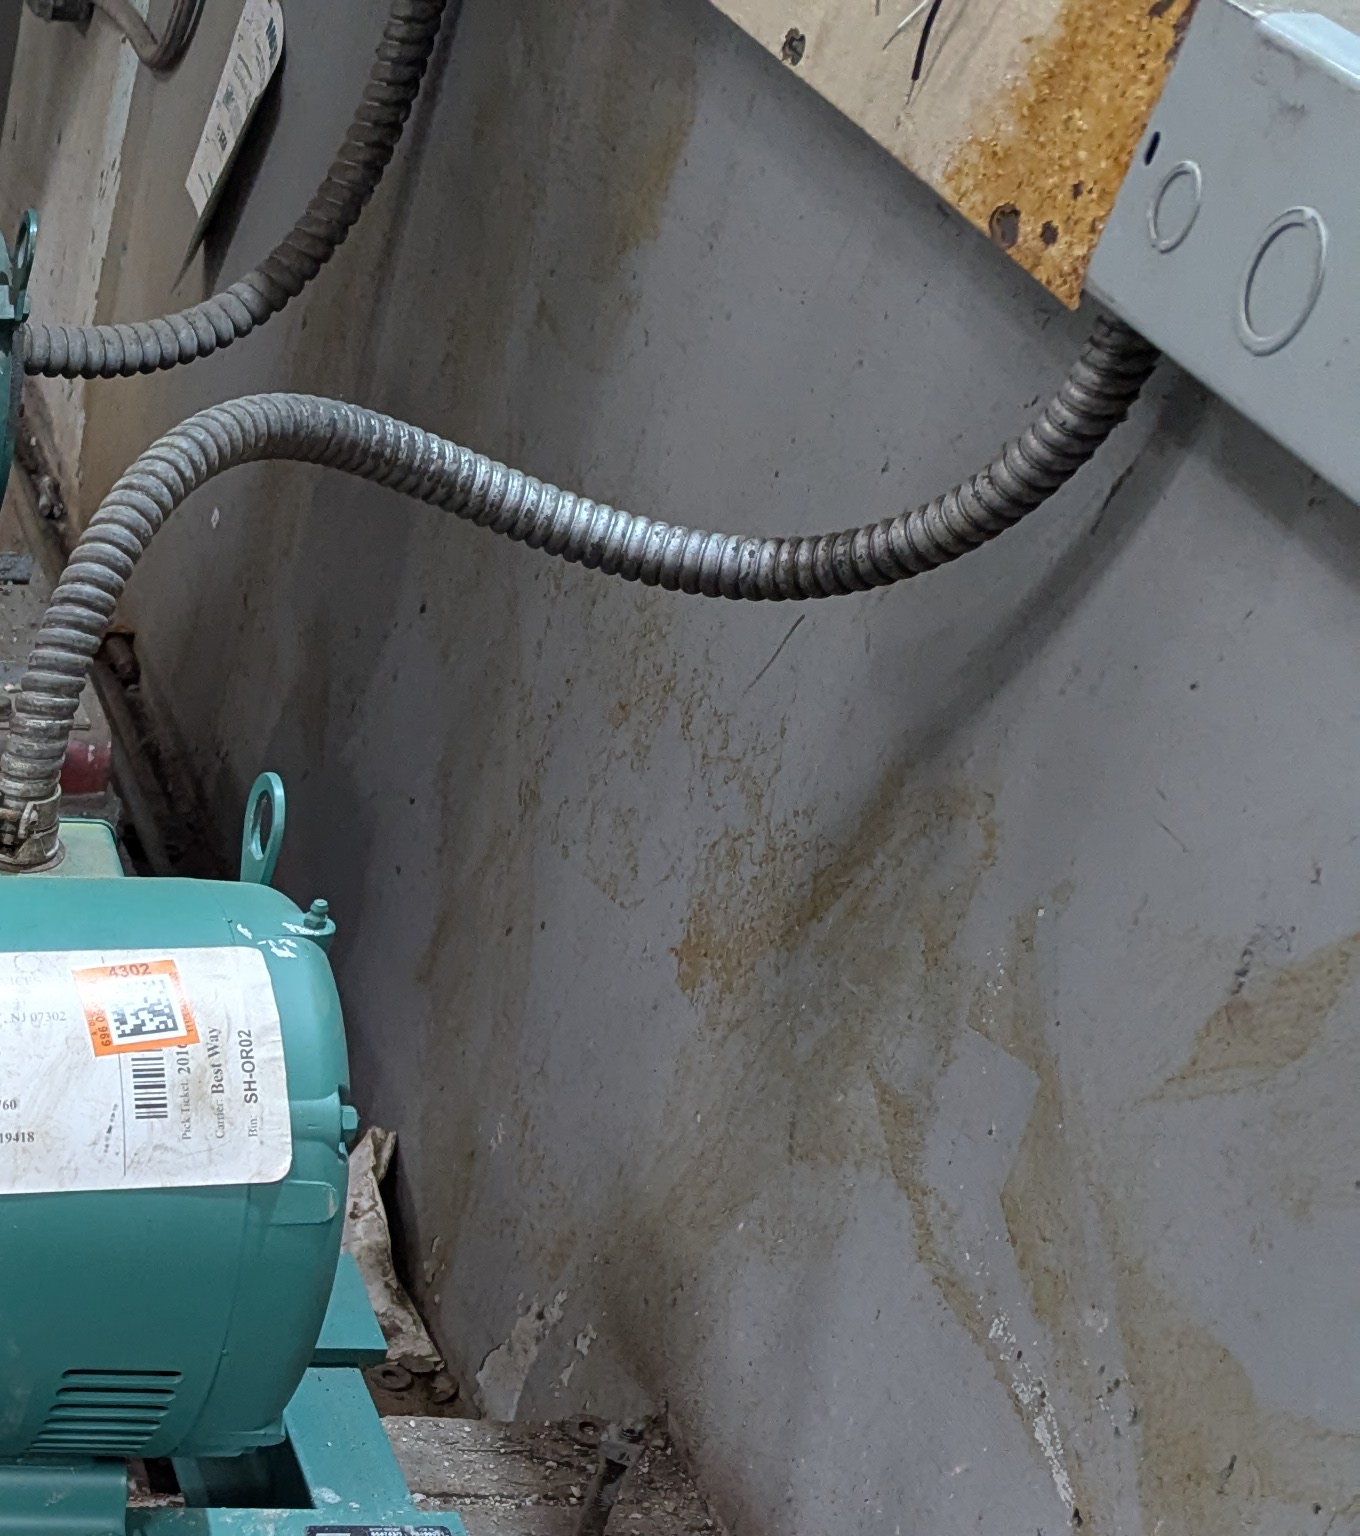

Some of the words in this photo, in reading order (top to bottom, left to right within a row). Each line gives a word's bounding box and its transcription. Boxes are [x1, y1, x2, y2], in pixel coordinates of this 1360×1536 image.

[108, 963, 152, 978] 4302
[11, 1013, 27, 1024] NJ
[30, 1011, 67, 1023] 07302
[207, 1026, 223, 1059] Way
[211, 1062, 225, 1095] Best
[237, 1029, 259, 1105] SH-OR02
[181, 1119, 191, 1140] Pick
[215, 1099, 225, 1139] Carrier:
[248, 1115, 258, 1138] Bin:
